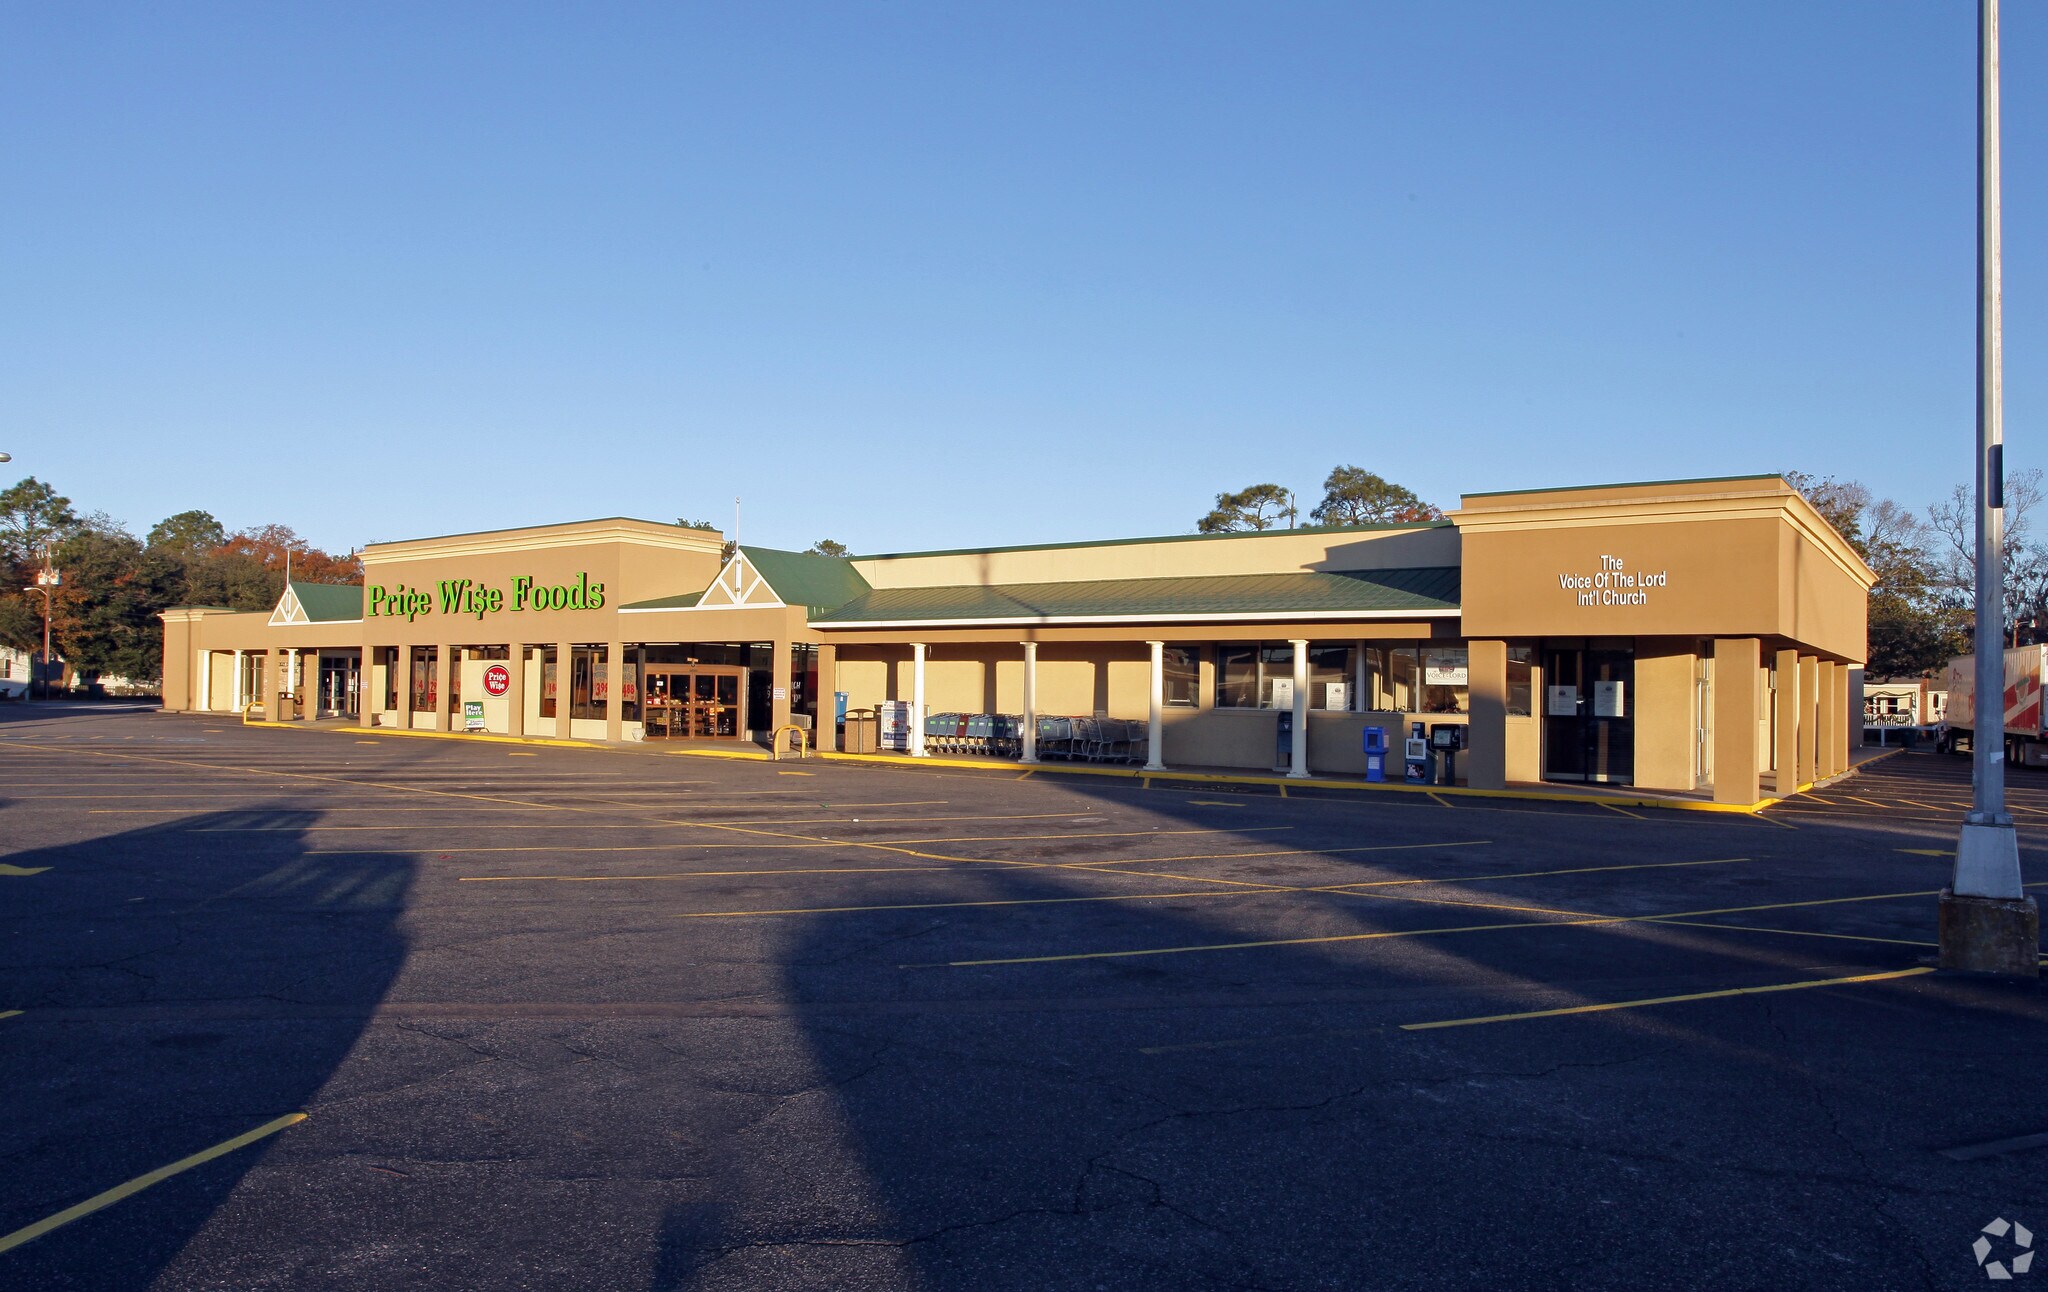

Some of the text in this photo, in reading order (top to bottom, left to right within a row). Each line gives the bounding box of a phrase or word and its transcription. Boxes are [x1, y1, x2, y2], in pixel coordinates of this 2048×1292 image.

[1600, 554, 1623, 570] The
[1559, 571, 1666, 589] Voice Of The Lord
[510, 571, 606, 612] Foods
[1577, 589, 1647, 606] Int'l Church
